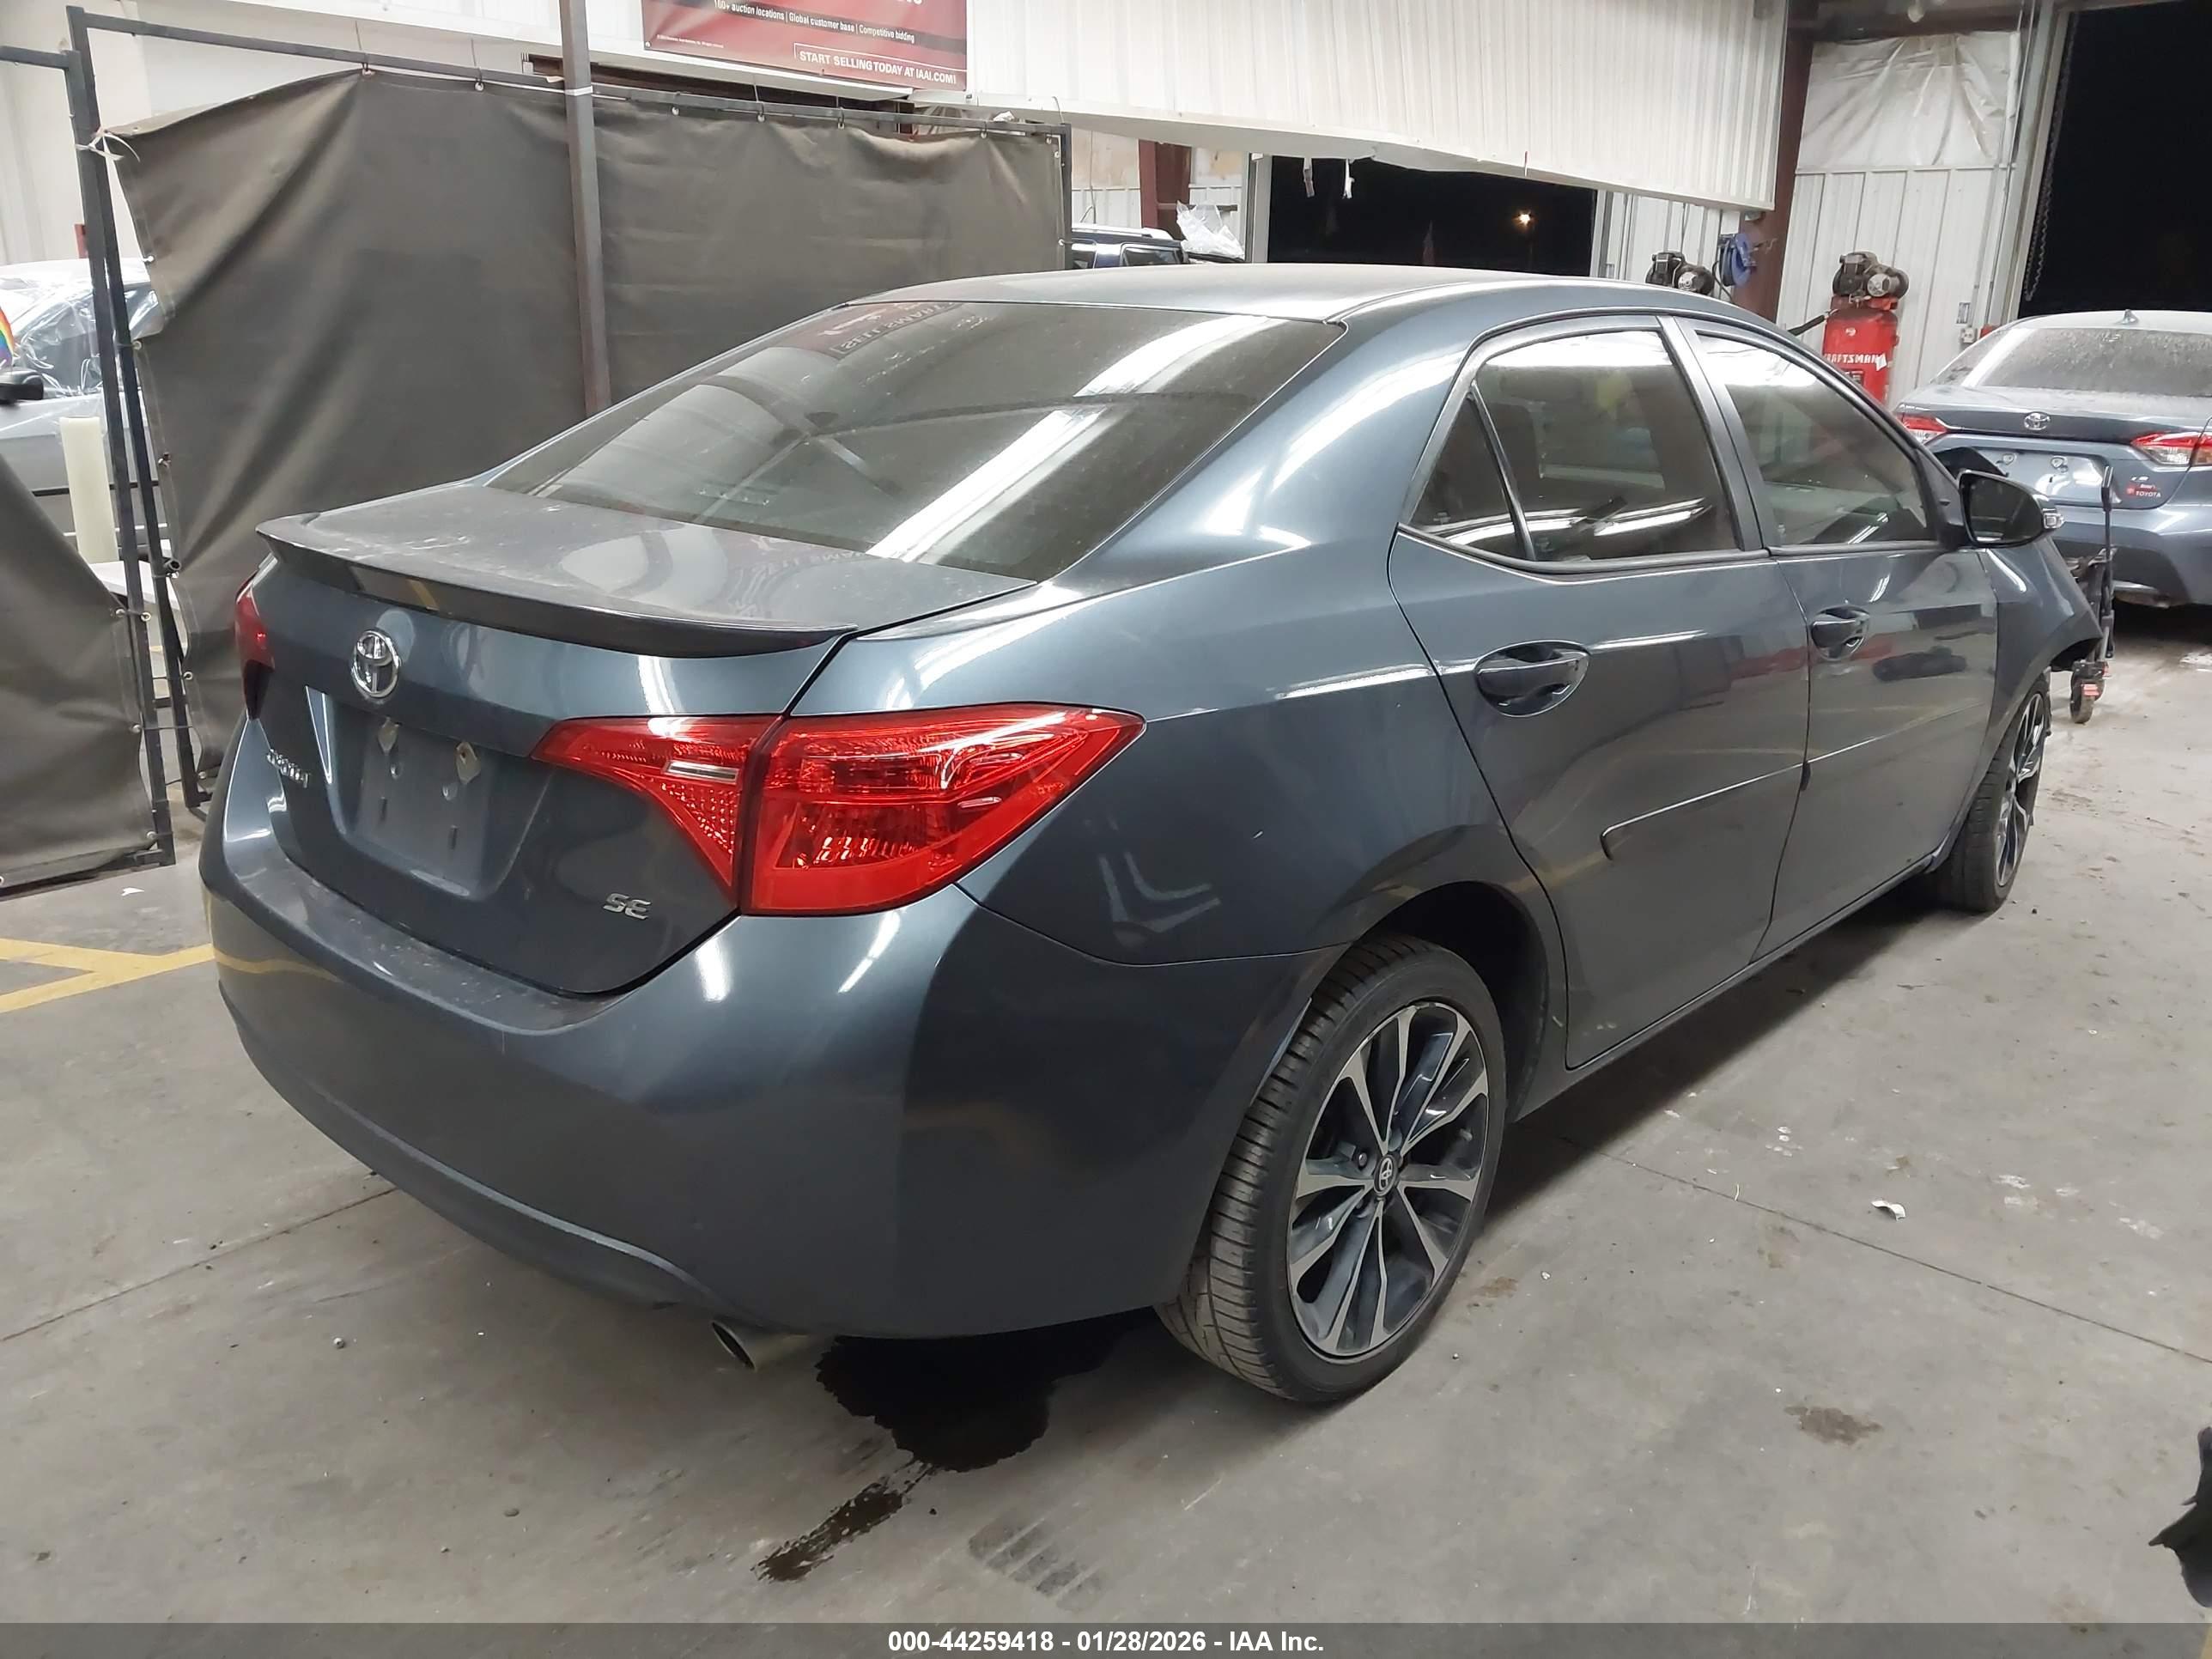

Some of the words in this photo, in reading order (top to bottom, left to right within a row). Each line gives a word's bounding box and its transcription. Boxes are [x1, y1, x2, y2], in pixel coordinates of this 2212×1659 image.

[732, 3, 755, 15] auction
[756, 6, 785, 21] locations
[789, 12, 810, 24] Global
[810, 18, 839, 29] customer
[840, 22, 855, 33] base
[859, 24, 895, 39] Competitive
[896, 30, 915, 45] bidding
[799, 51, 831, 65] START
[834, 57, 873, 71] SELLING
[873, 61, 903, 76] TODAY
[903, 64, 915, 78] AT
[1824, 353, 1882, 364] RAFTSMAN
[603, 892, 652, 921] SE
